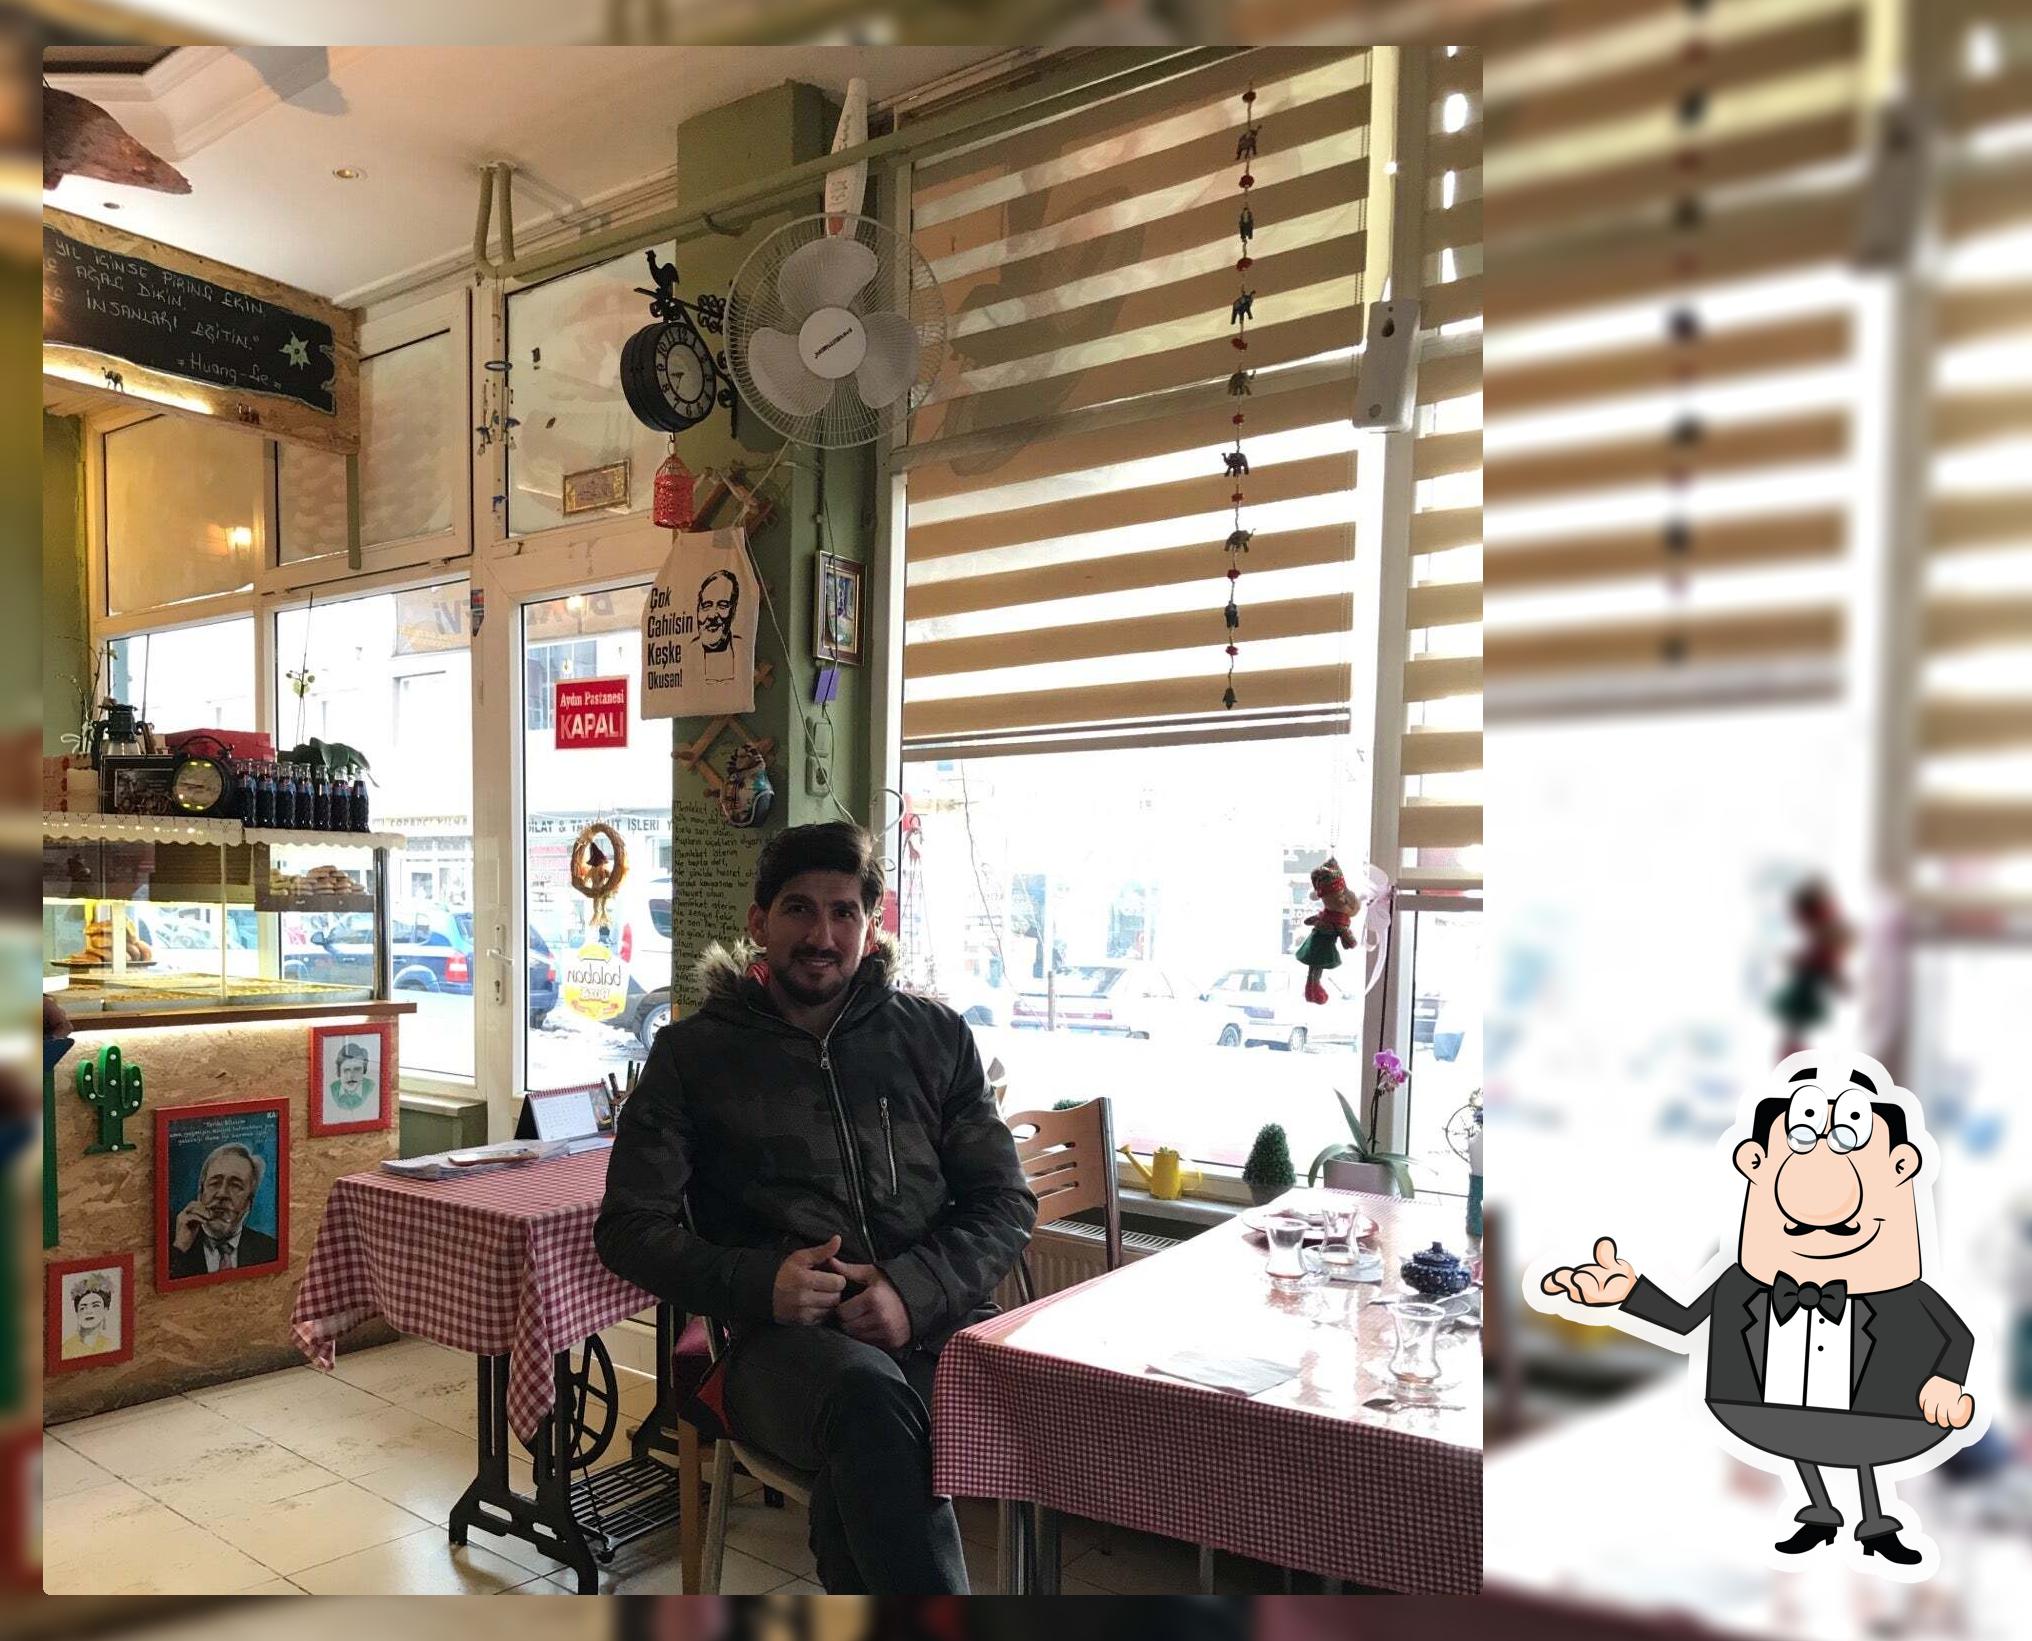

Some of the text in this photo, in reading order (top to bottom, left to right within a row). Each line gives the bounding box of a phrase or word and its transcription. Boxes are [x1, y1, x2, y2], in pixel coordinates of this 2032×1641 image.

[650, 586, 672, 613] Çok
[647, 611, 694, 638] Cahilsin
[647, 640, 682, 669] Keşke
[647, 668, 683, 690] Okusan!
[584, 688, 625, 706] Pastanesi
[560, 711, 625, 740] KAPALI
